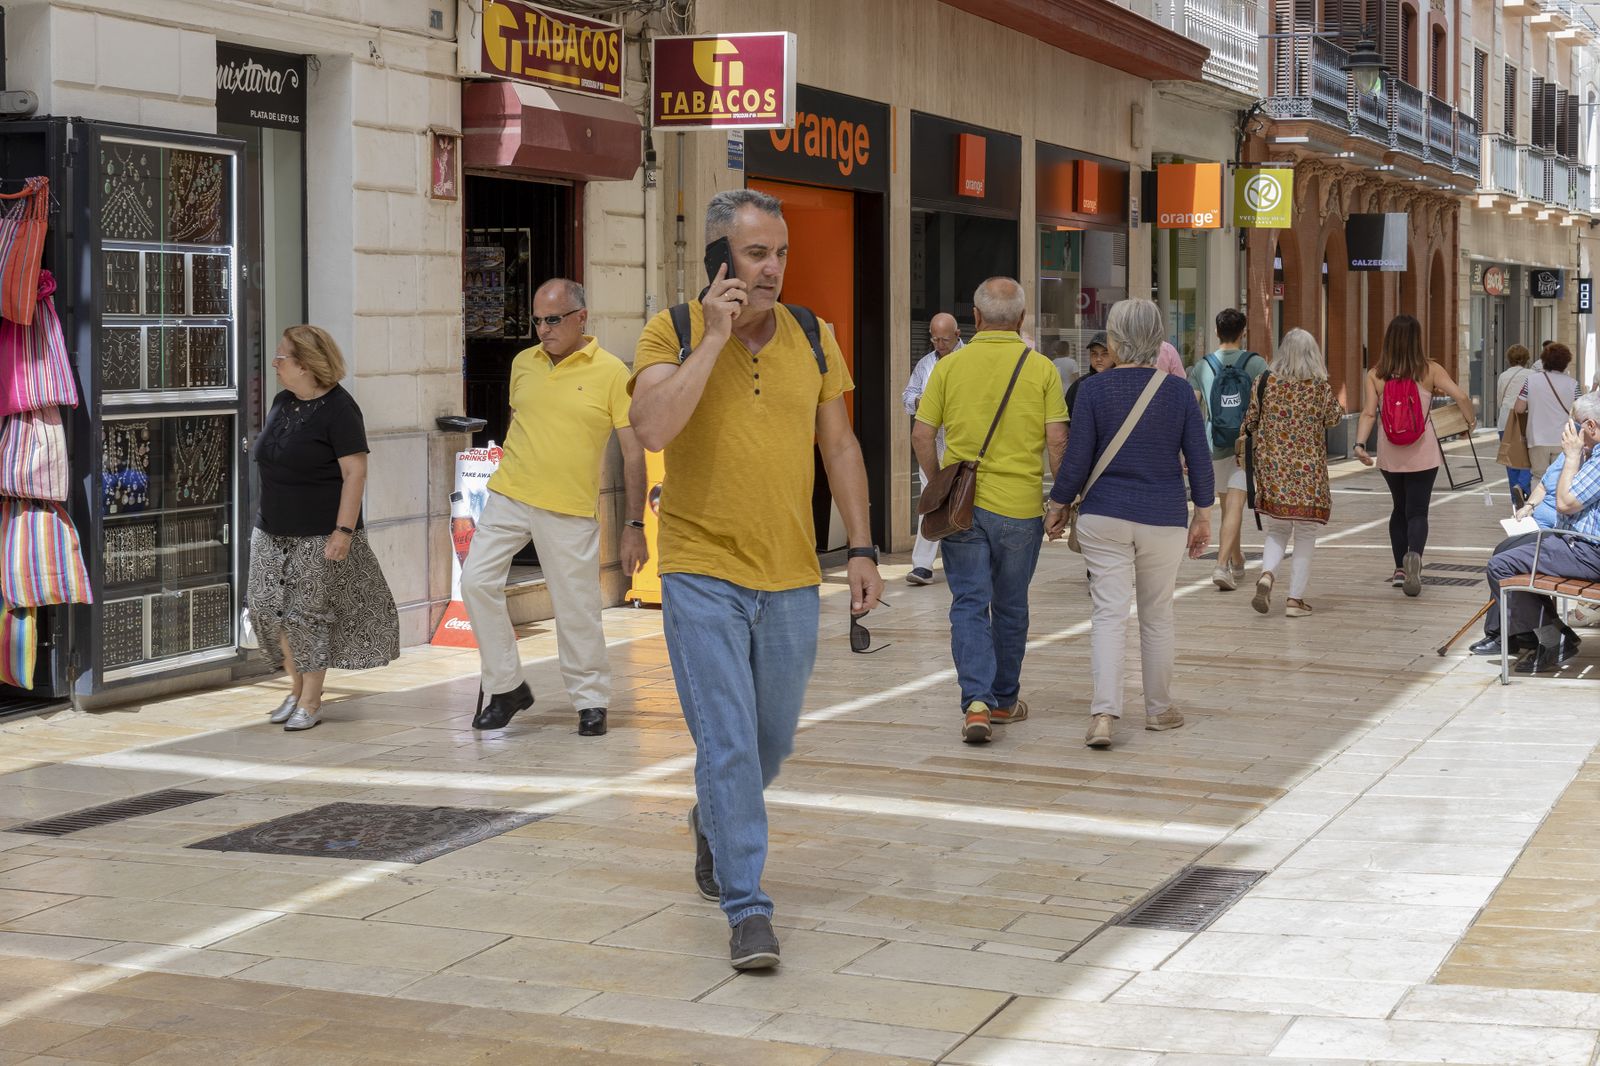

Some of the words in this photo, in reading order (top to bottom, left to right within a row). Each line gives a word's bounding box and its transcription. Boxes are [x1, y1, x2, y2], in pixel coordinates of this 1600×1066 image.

[524, 11, 619, 75] TABACOS
[660, 88, 776, 114] TABACOS
[250, 109, 269, 120] PLATA
[269, 112, 276, 120] DE
[277, 113, 288, 122] LEY
[965, 179, 984, 194] orange
[1082, 199, 1098, 213] orange
[1160, 211, 1213, 227] orange
